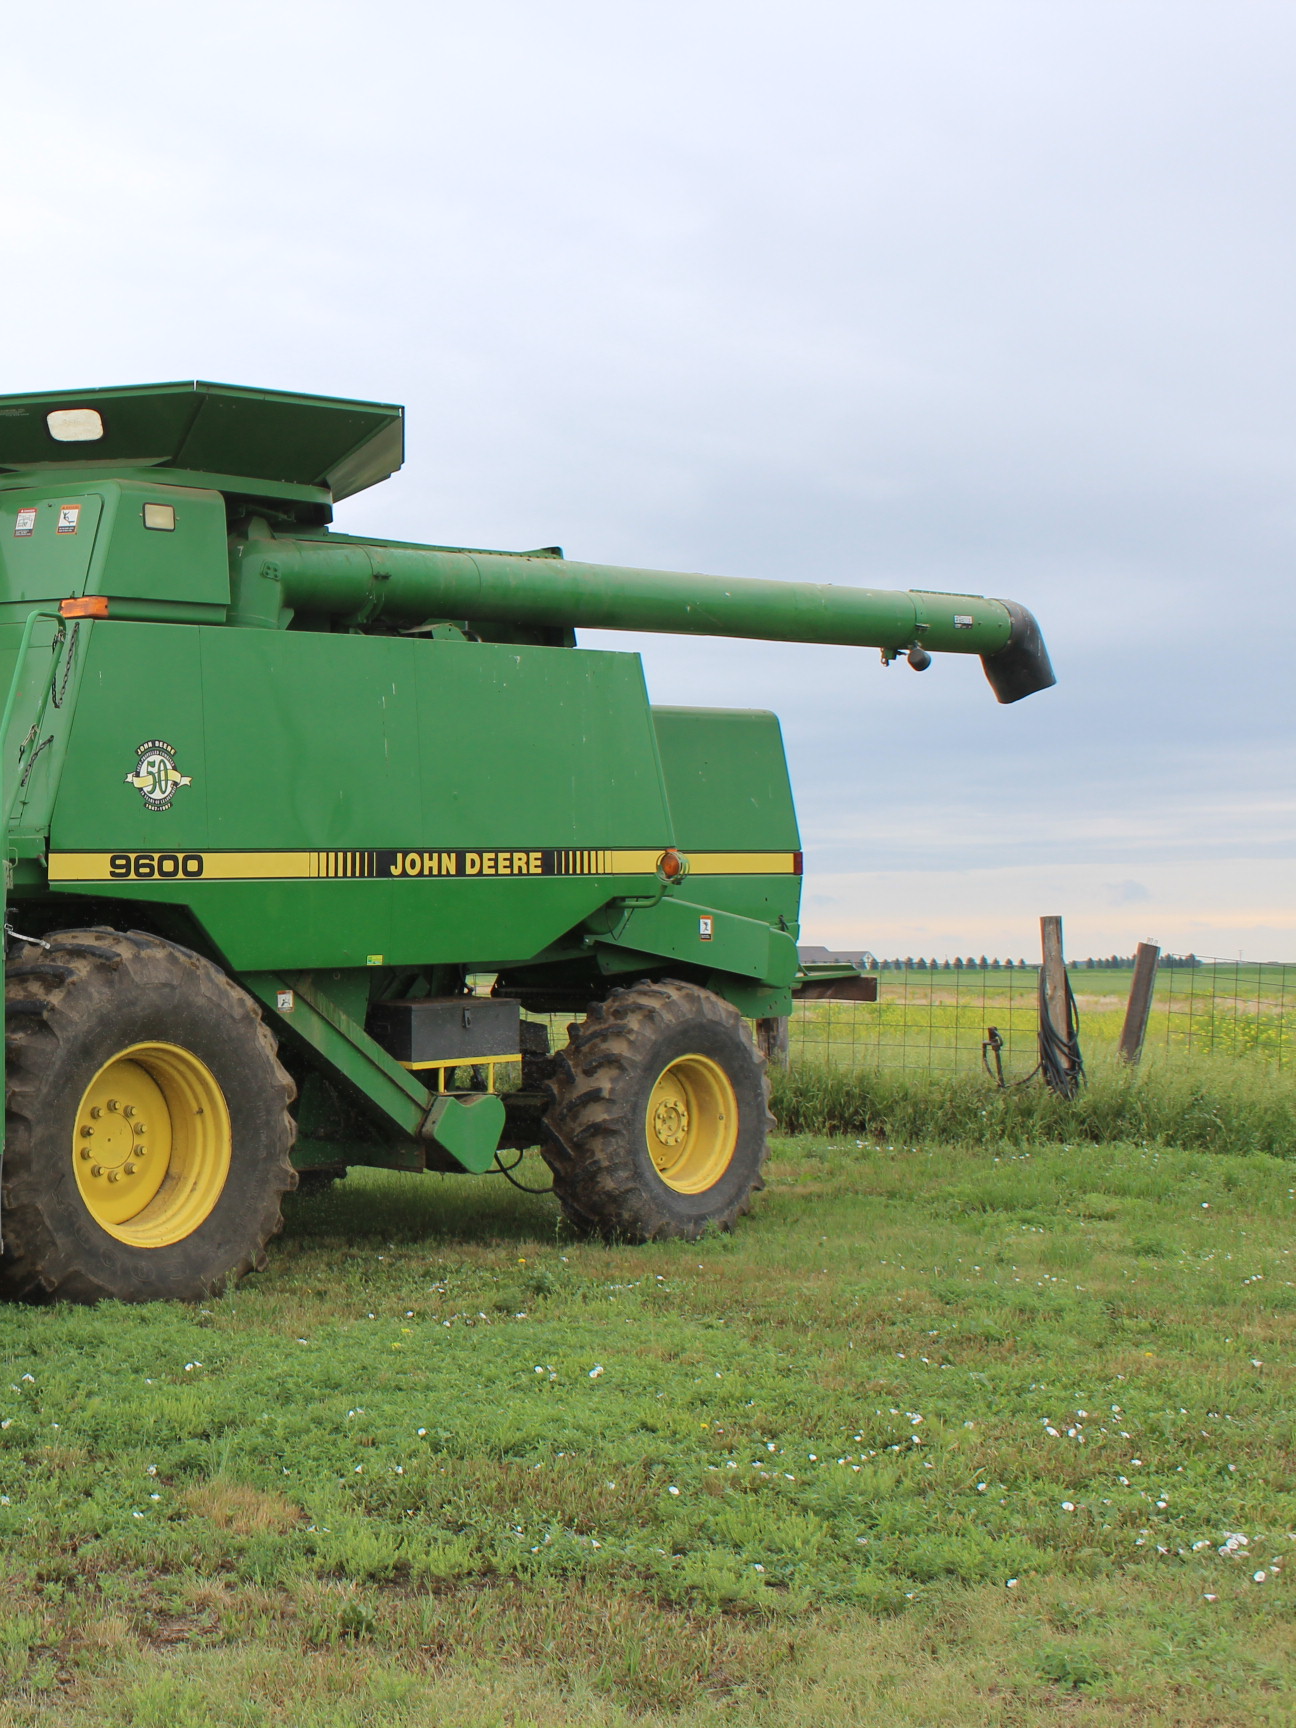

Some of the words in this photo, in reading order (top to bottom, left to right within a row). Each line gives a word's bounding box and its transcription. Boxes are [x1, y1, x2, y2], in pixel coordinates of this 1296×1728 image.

[137, 741, 153, 755] JOHN
[155, 740, 175, 755] DEERE
[146, 759, 168, 794] 50
[109, 854, 204, 878] 9600
[390, 852, 456, 876] JOHN
[465, 852, 542, 875] DEERE
